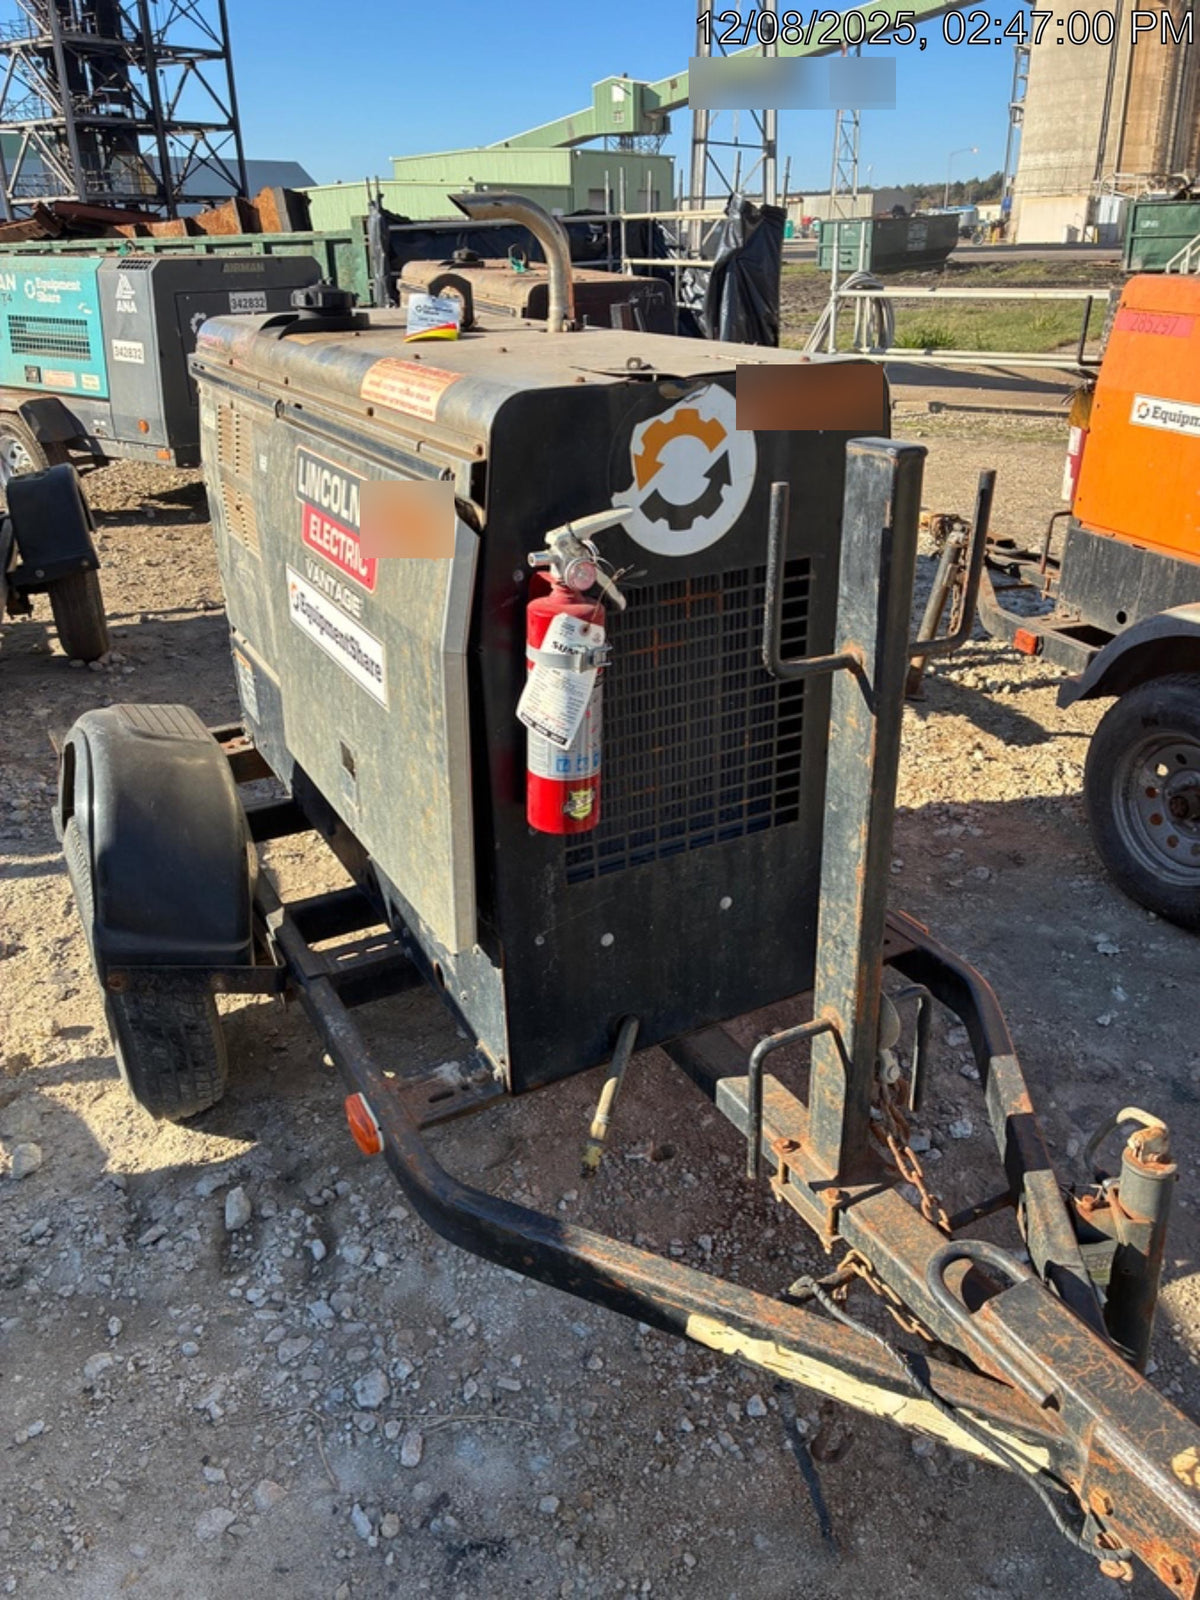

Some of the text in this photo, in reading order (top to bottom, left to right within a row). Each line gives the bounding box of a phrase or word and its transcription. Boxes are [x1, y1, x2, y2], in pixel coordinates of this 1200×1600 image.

[117, 300, 137, 313] ANA
[230, 296, 266, 310] 342832
[297, 457, 361, 528] LINCOLN
[309, 513, 370, 577] ELECTRIC
[304, 557, 362, 620] VANTAGE
[300, 591, 384, 684] EquipmentShare
